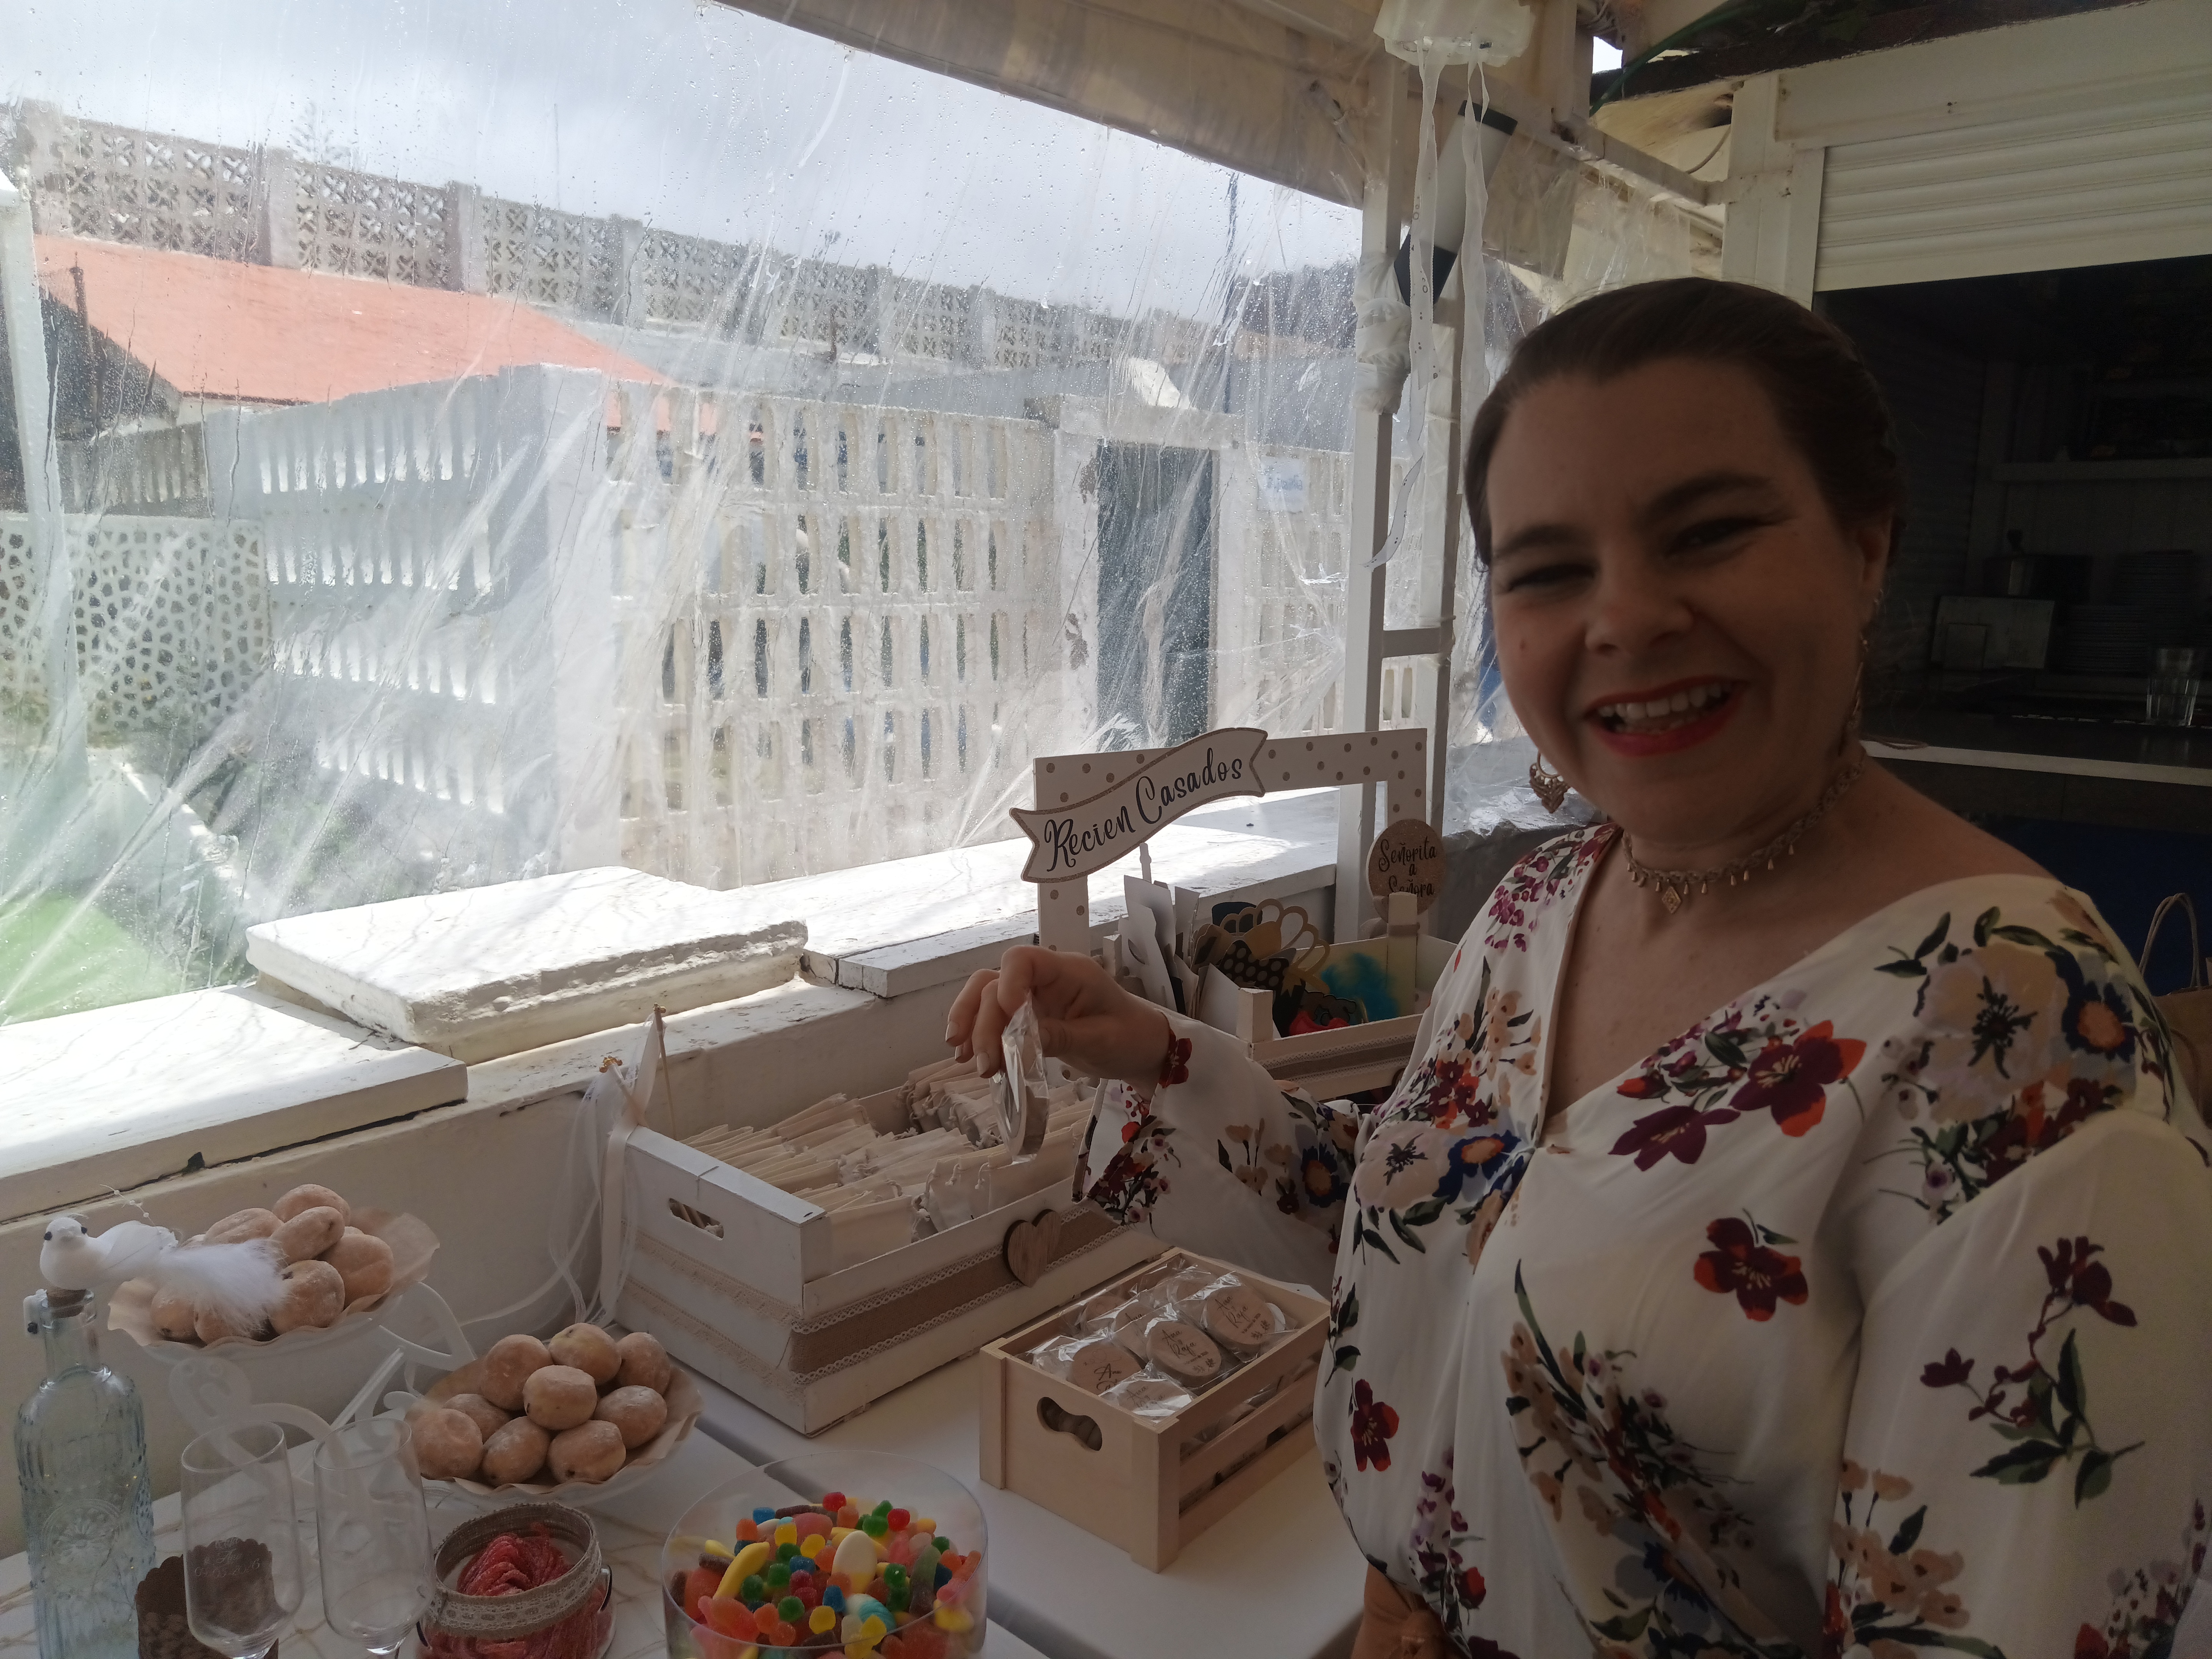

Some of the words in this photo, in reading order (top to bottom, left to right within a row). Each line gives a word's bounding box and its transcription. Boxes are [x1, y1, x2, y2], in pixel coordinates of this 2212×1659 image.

[1044, 805, 1136, 872] Recien
[1136, 747, 1242, 824] Casados
[1378, 835, 1437, 872] Señorita
[1409, 863, 1417, 876] a
